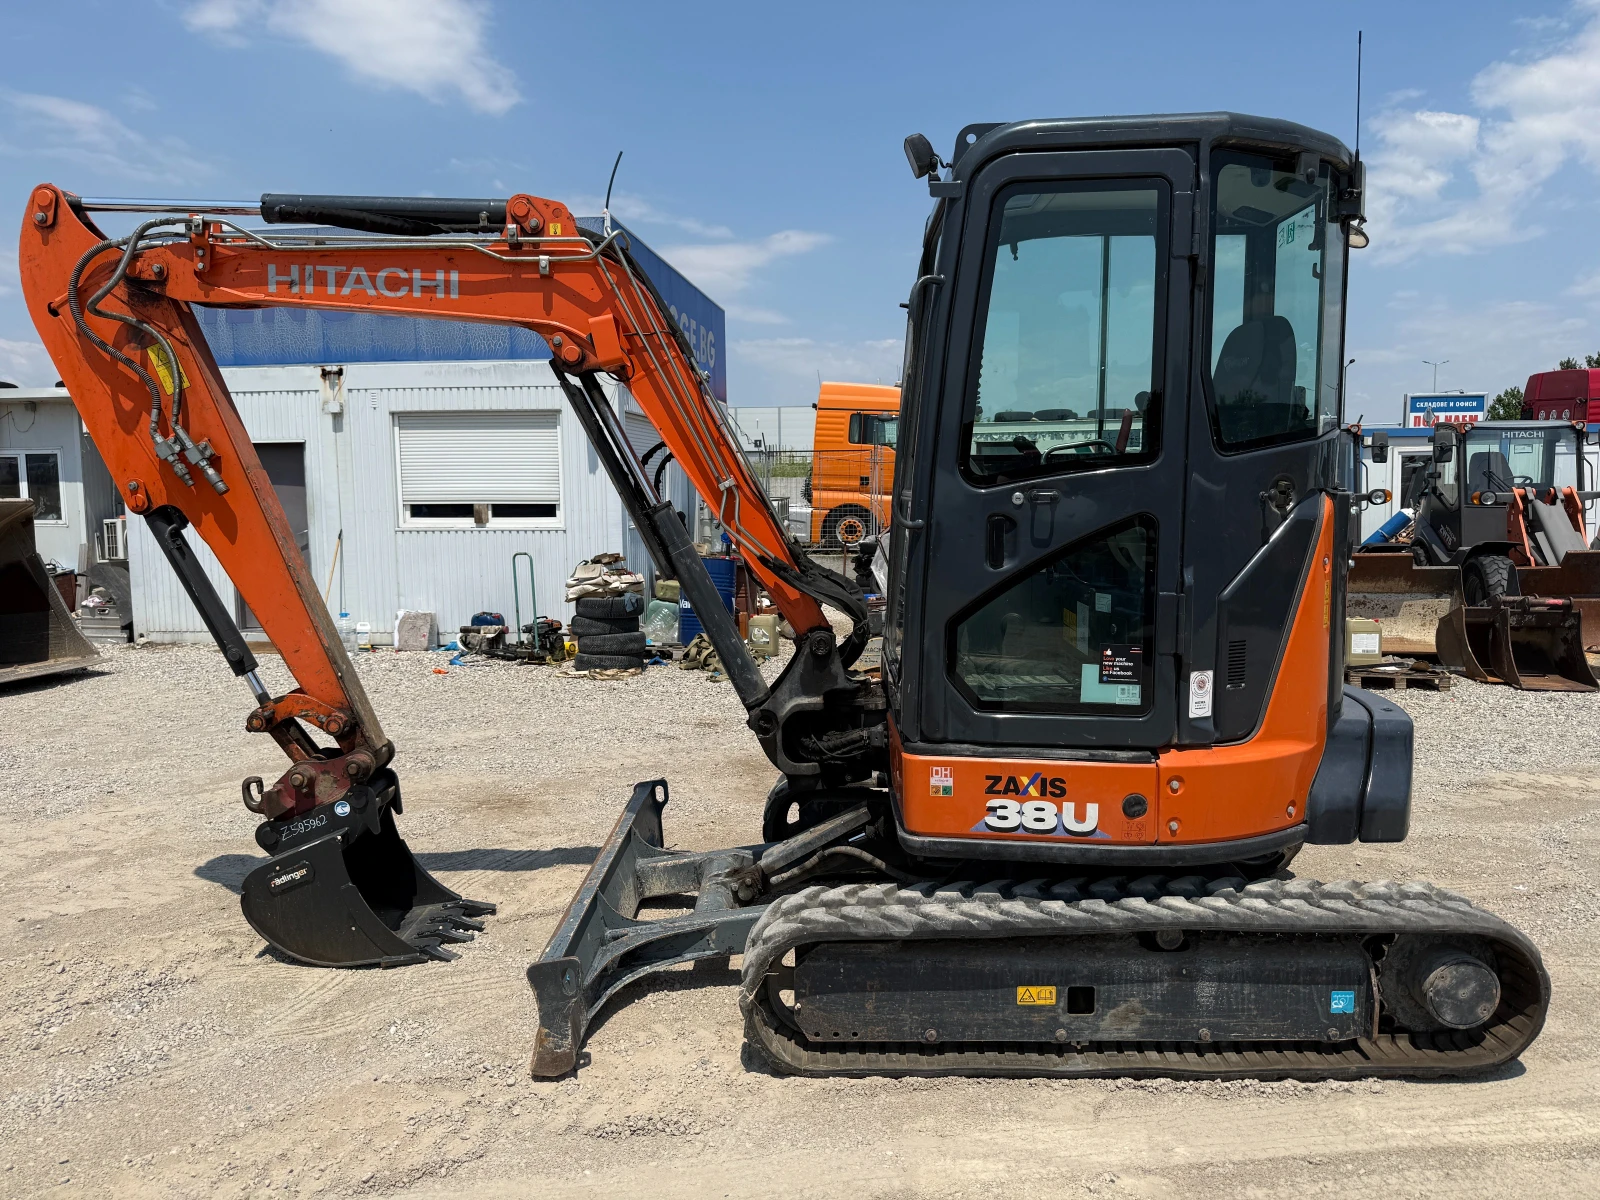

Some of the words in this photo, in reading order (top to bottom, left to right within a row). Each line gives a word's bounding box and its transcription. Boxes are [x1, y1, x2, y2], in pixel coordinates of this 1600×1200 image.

[267, 263, 459, 299] HITACHI
[1502, 431, 1545, 439] HITACHI
[984, 772, 1067, 798] ZAXIS
[280, 814, 328, 841] Z595962
[984, 798, 1099, 837] 38U
[270, 867, 308, 888] rädlinger
